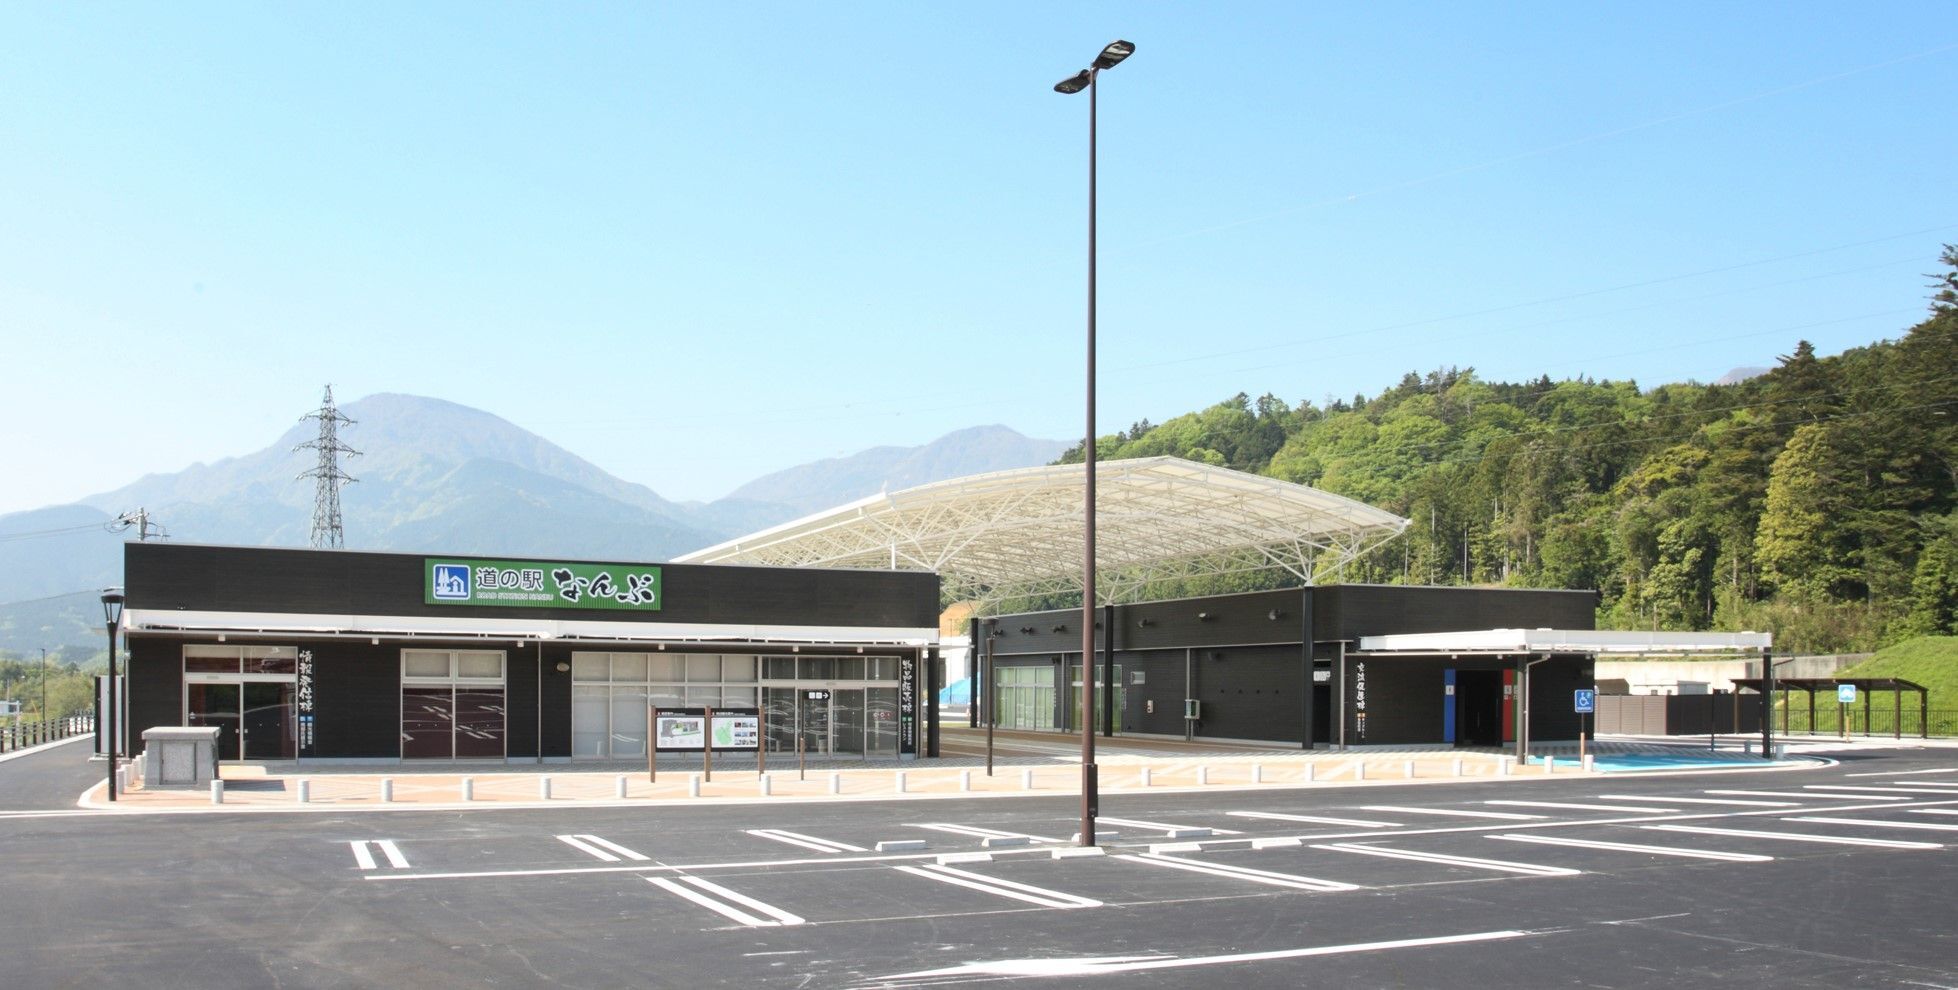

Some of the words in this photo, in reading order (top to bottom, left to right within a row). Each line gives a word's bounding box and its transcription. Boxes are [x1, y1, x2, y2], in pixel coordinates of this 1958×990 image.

[476, 567, 544, 590] 道の駅
[551, 567, 655, 606] なんぶ
